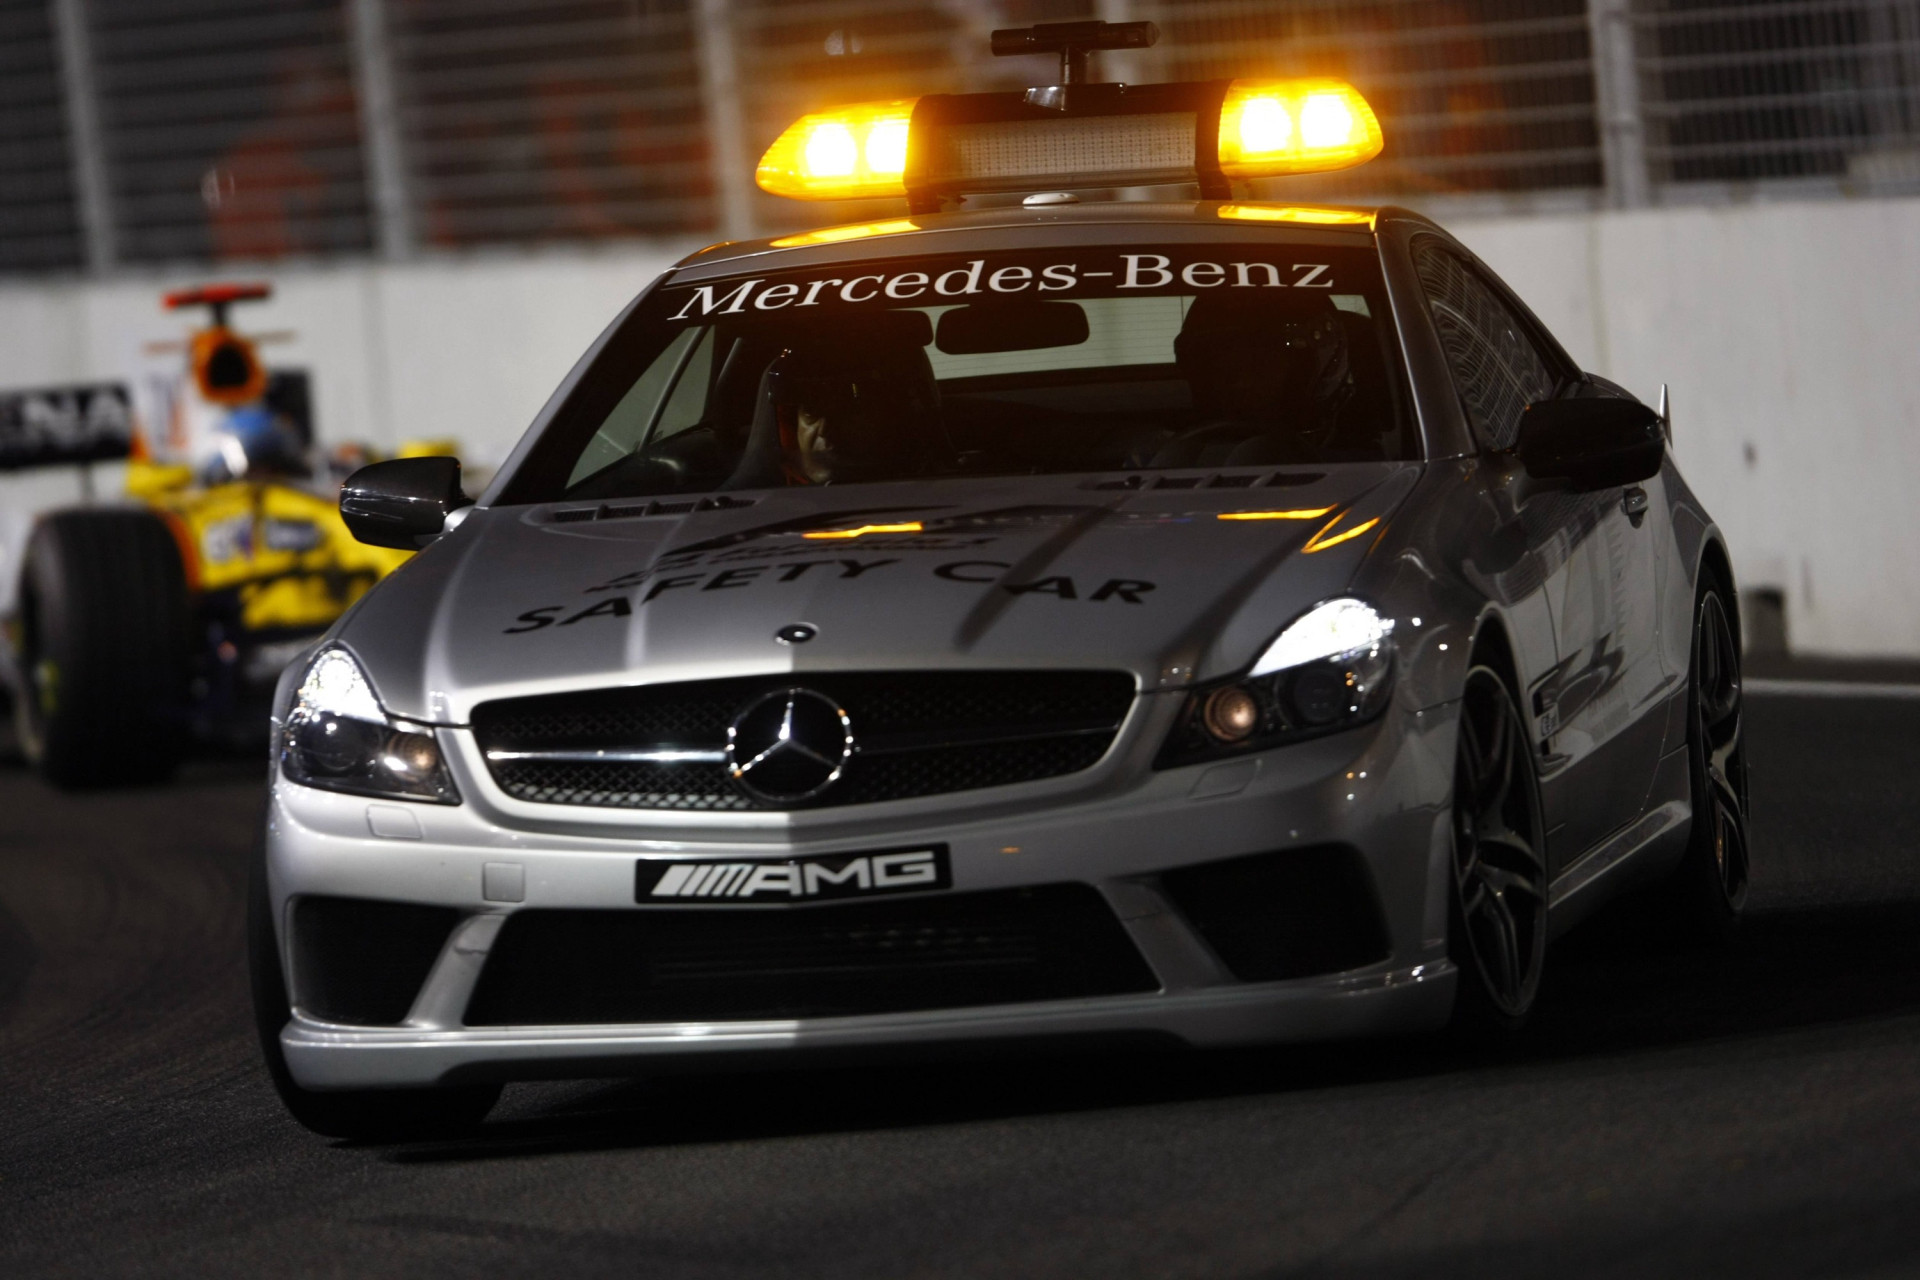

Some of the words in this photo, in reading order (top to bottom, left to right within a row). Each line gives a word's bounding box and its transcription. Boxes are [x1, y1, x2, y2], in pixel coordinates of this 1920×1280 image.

[667, 254, 1334, 321] Mercedes-Benz
[502, 559, 901, 634] SAFETY
[933, 561, 1156, 605] CAR
